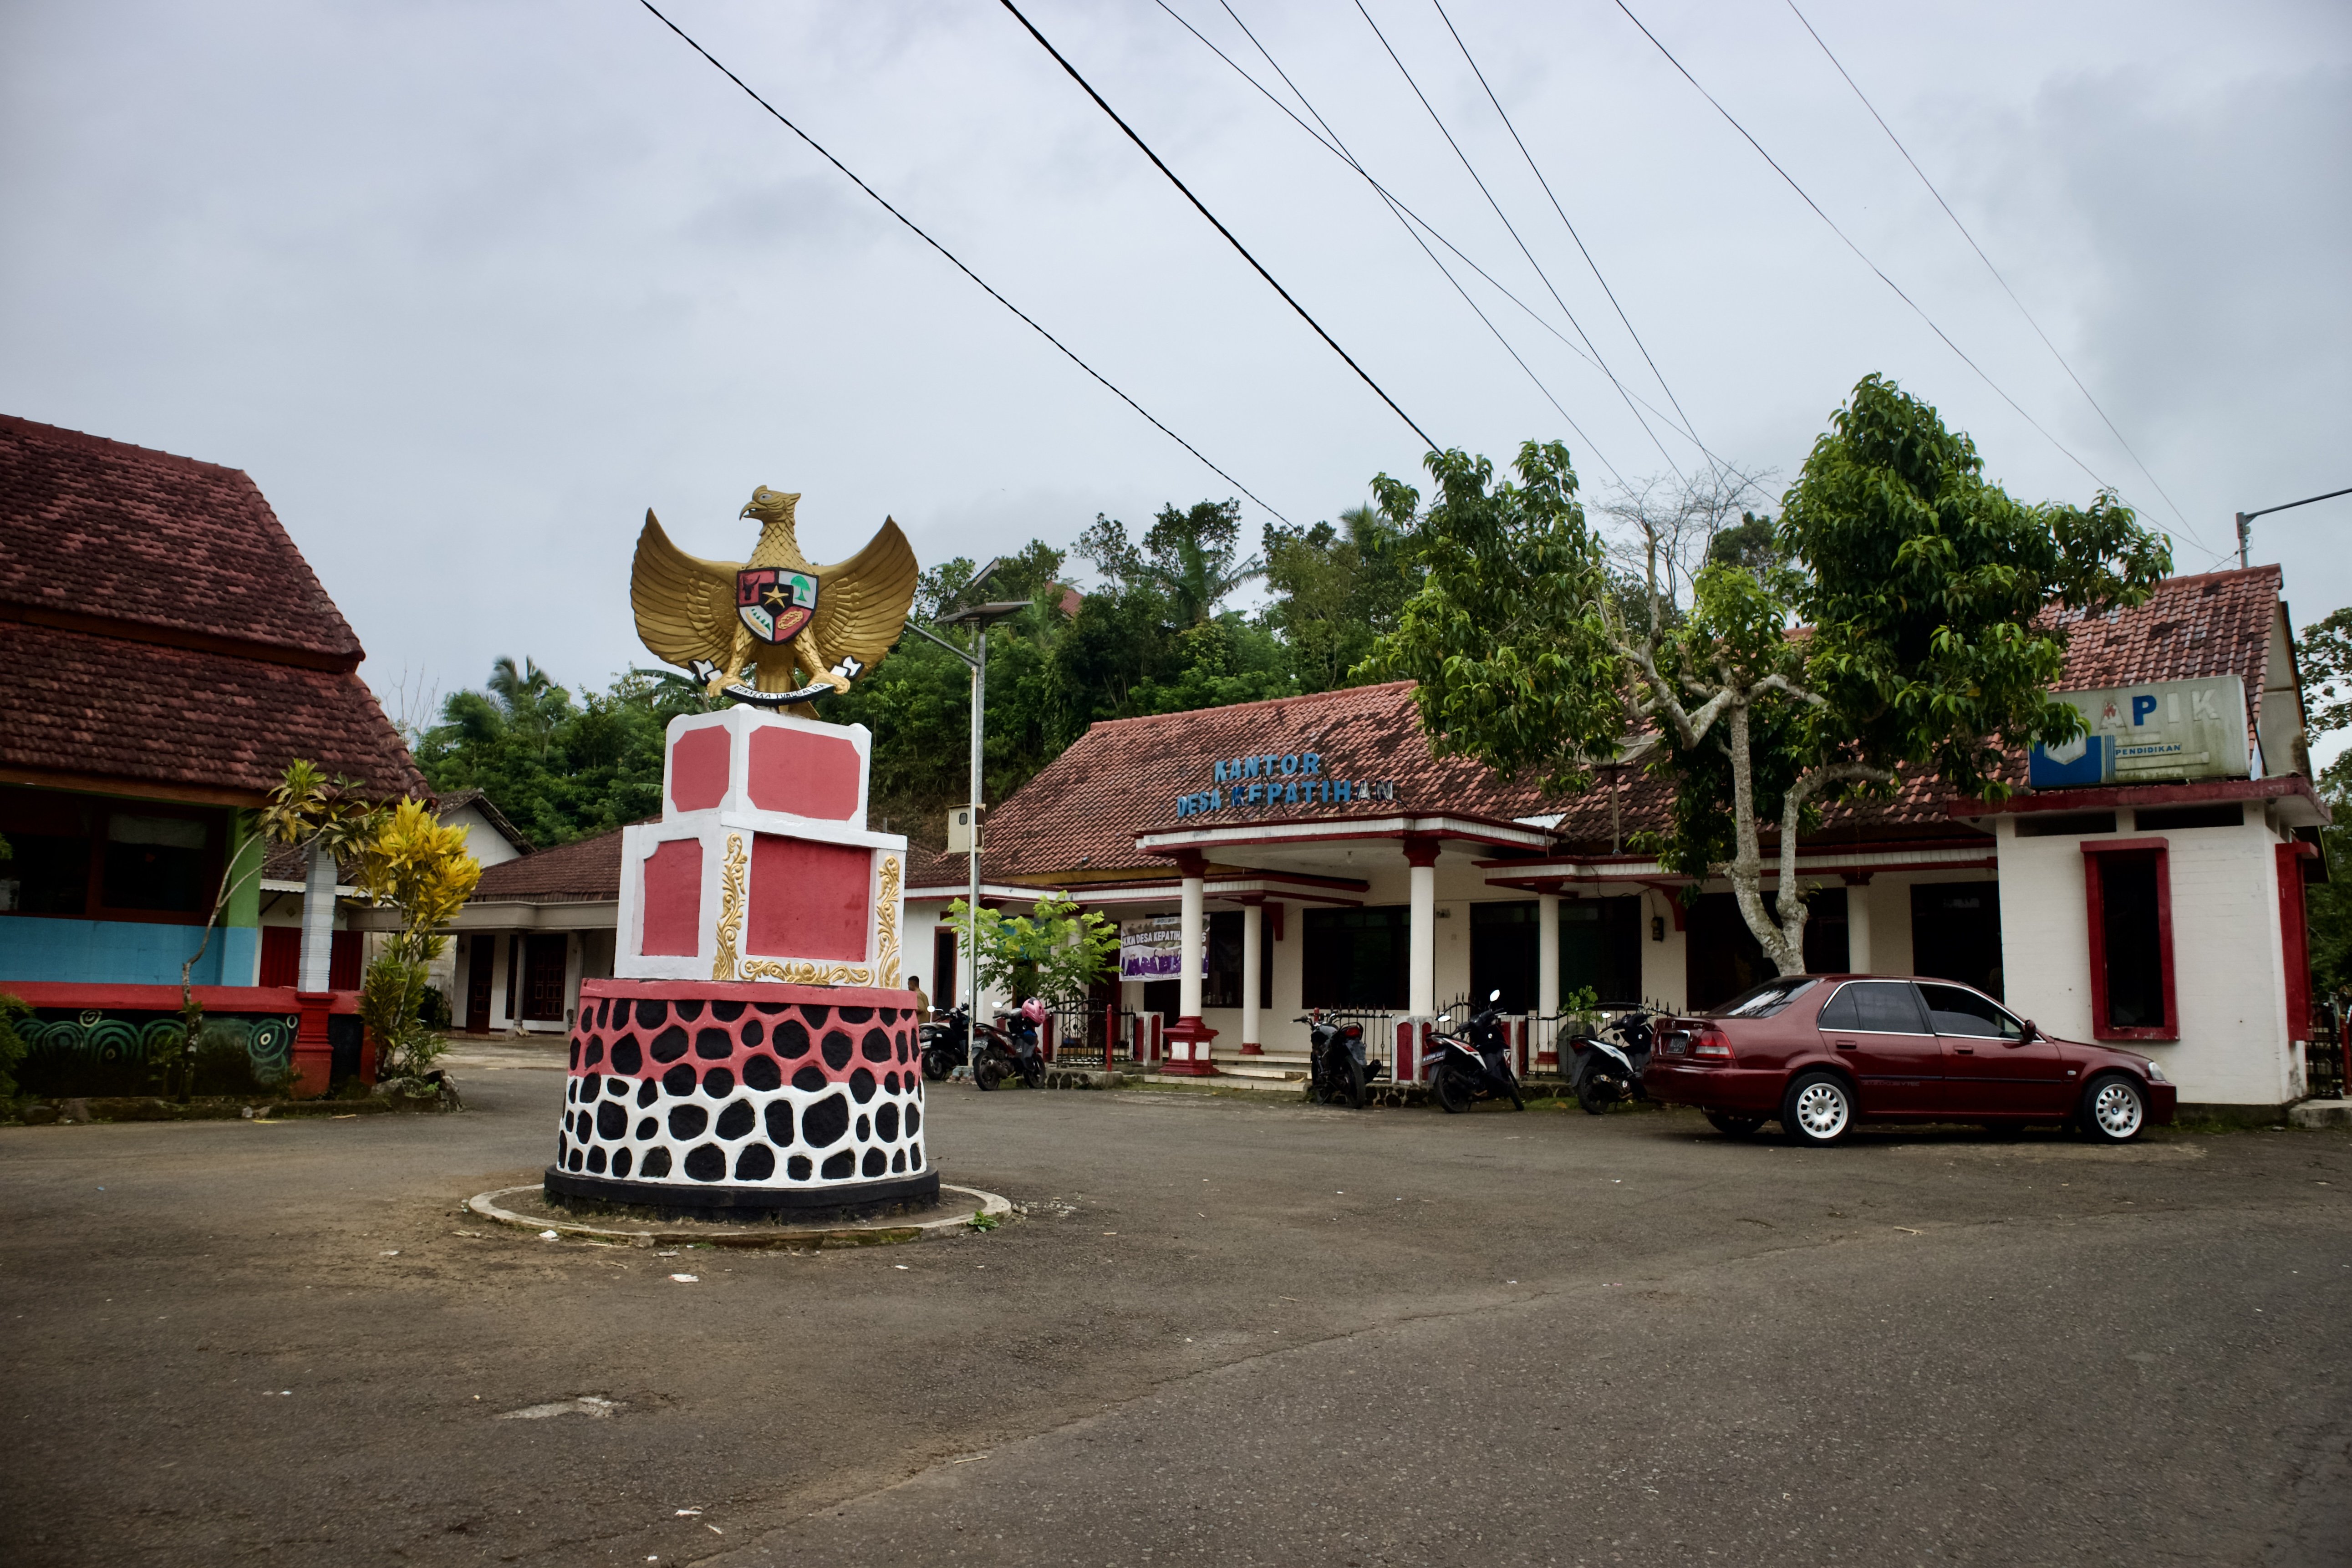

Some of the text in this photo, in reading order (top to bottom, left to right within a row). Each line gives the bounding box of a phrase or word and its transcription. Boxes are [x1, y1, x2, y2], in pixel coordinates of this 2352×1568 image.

[2080, 689, 2220, 729] APIK
[2115, 744, 2181, 755] PENDIDIKAN
[1215, 753, 1320, 782] KANTOR
[1177, 779, 1393, 818] DESA KEPATIHAN
[1123, 935, 1136, 947] KKN
[1136, 932, 1153, 944] DESA
